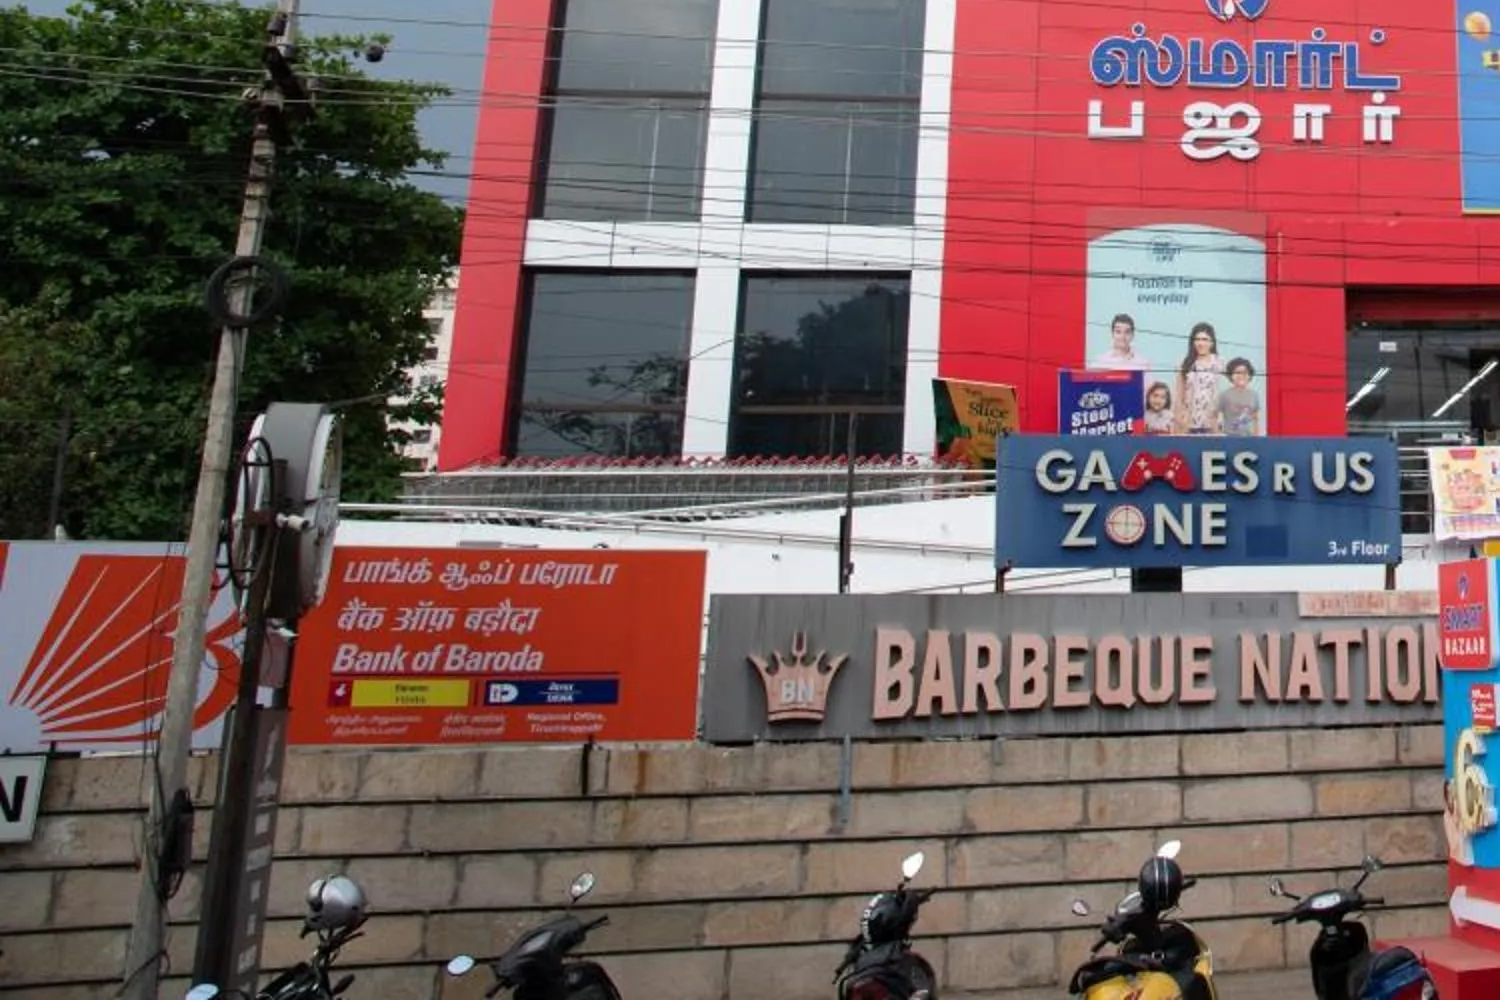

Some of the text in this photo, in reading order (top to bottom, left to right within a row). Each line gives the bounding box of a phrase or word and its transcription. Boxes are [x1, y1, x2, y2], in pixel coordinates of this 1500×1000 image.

[1090, 23, 1401, 89] ஸ்மார்ட்
[1072, 404, 1114, 427] Steel
[1273, 463, 1296, 492] R
[1311, 451, 1375, 493] US
[1351, 540, 1390, 556] Floor
[343, 557, 619, 591] பாங்க் ஆஃப் பரோடா
[337, 597, 388, 631] बैंक
[464, 599, 542, 637] बड़ौदा
[332, 643, 543, 672] Bank of Baroda
[872, 626, 1216, 722] BARBEQUE
[781, 679, 815, 704] BN
